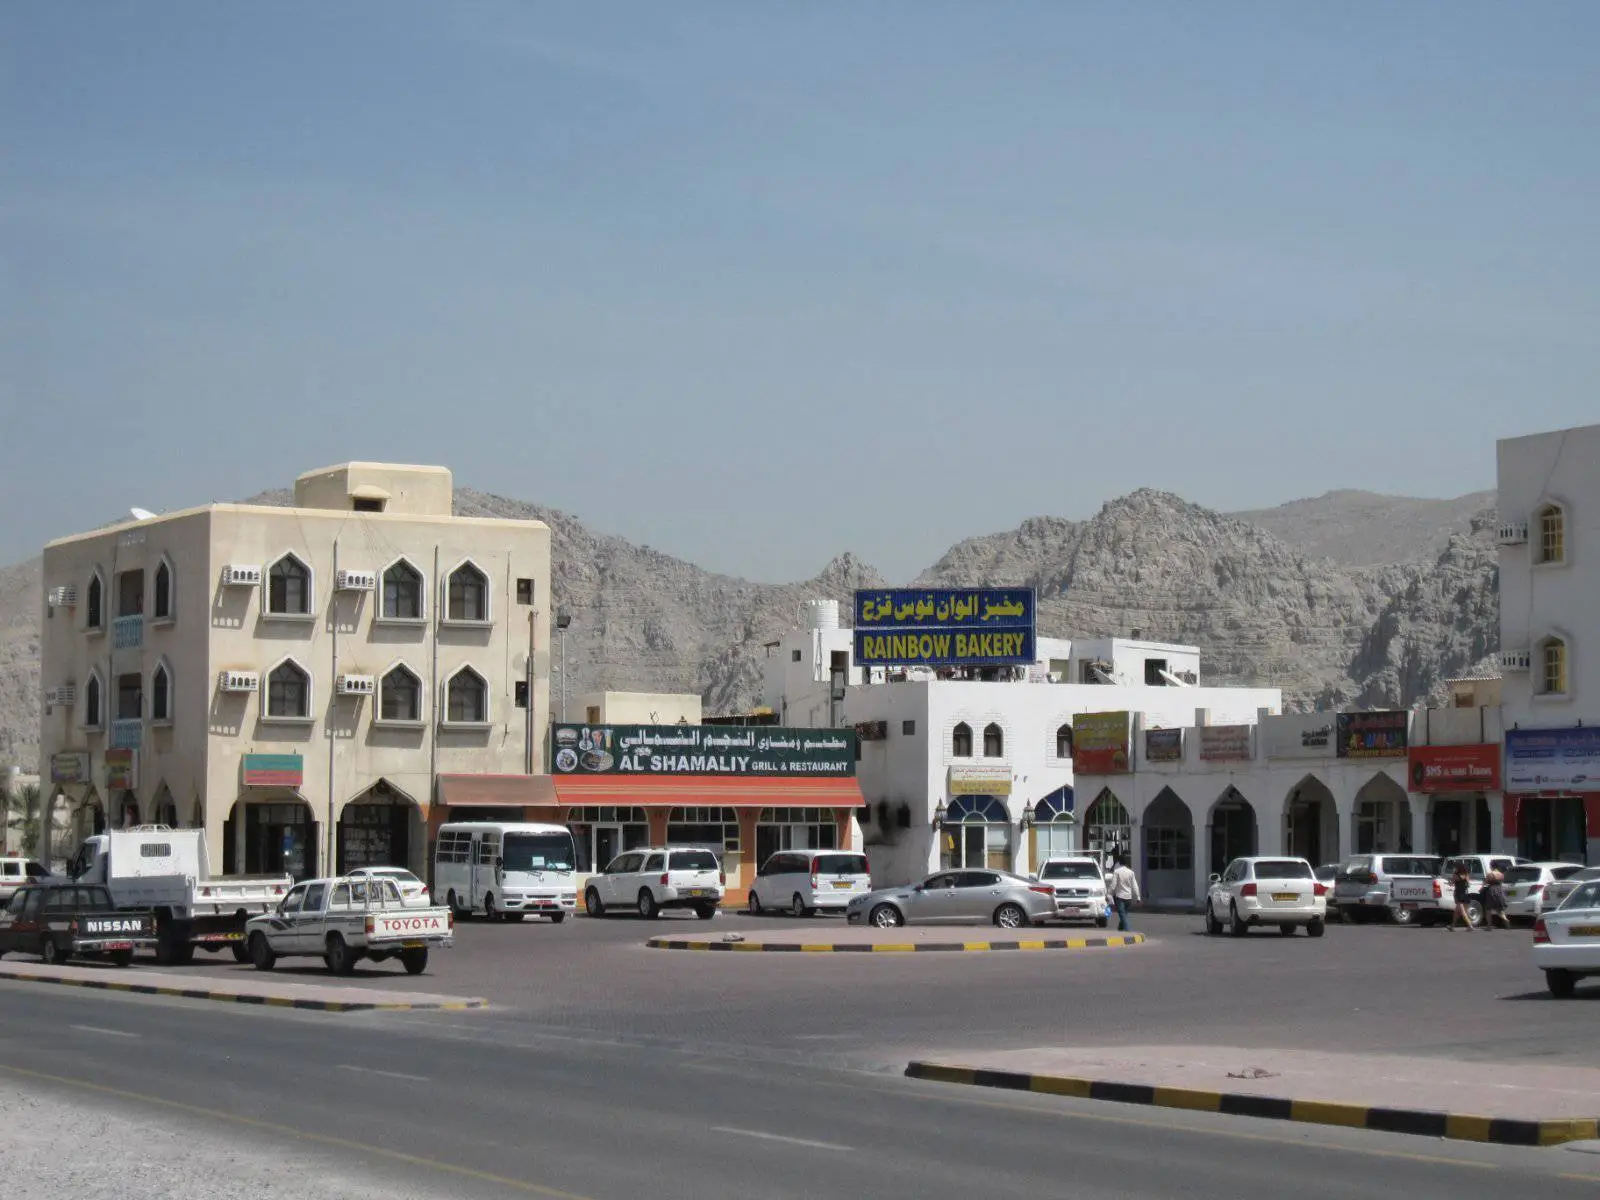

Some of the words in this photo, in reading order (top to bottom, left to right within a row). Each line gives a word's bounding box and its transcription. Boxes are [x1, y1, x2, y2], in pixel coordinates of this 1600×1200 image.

[862, 595, 892, 621] قزح
[894, 595, 935, 621] قوس
[980, 595, 1024, 621] مخبز
[863, 633, 950, 659] RAINBOW
[956, 632, 1025, 657] BAKERY
[619, 729, 700, 752] الشمالي
[703, 731, 755, 751] النجم
[803, 736, 847, 751] مطعم
[619, 755, 644, 771] AL
[650, 755, 749, 772] SHAMALIY
[751, 761, 778, 771] GRILL
[780, 761, 787, 771] &
[789, 761, 848, 772] RESTAURANT
[1400, 887, 1427, 896] TOYOTA
[87, 920, 142, 932] NISSAN
[384, 917, 439, 930] TOYOTA
